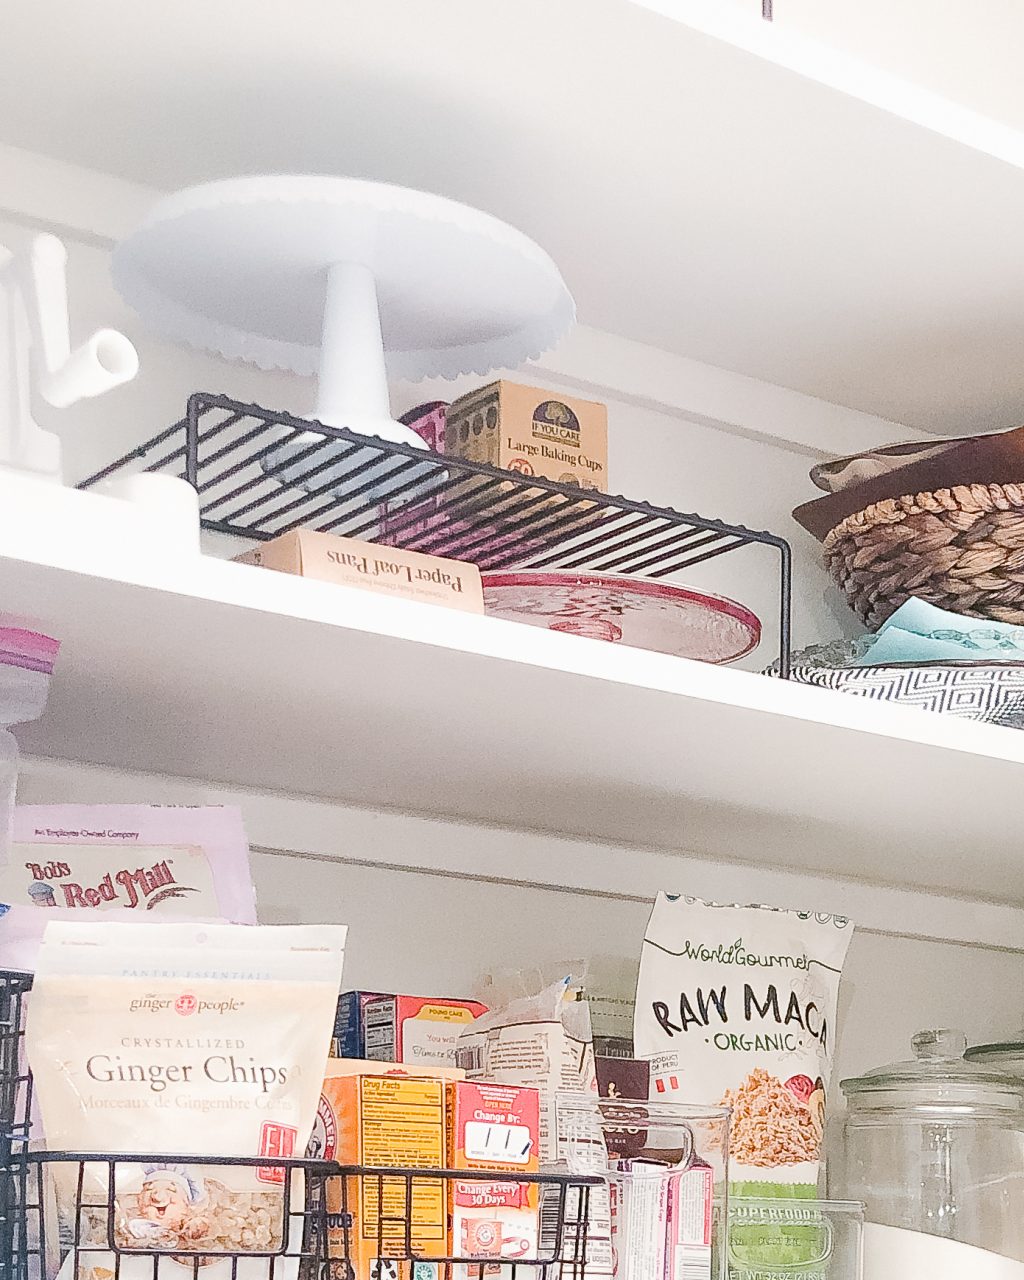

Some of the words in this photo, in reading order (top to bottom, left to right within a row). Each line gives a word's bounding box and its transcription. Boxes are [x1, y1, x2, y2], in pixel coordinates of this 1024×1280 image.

[532, 421, 539, 431] IF
[540, 423, 558, 435] YOU
[559, 429, 581, 441] CARE
[508, 438, 539, 456] Large
[541, 444, 576, 467] Baking
[577, 455, 603, 471] Cups
[327, 550, 368, 575] Pans
[371, 559, 413, 583] Loaf
[414, 567, 464, 593] Paper
[107, 829, 140, 840] Company
[25, 861, 71, 880] Bob's
[60, 873, 119, 909] Red
[116, 859, 177, 909] Mill
[129, 997, 172, 1012] ginger
[197, 999, 239, 1014] people
[652, 986, 728, 1036] RAW
[120, 1037, 247, 1049] CRYSTALLIZED
[713, 1033, 796, 1053] ORGANIC
[86, 1054, 193, 1092] Ginger
[203, 1056, 288, 1093] Chips
[363, 1080, 380, 1090] Drug
[381, 1081, 400, 1090] Facts
[80, 1095, 150, 1110] Morceaux
[153, 1095, 171, 1109] de
[175, 1095, 251, 1113] Gingembre
[473, 1110, 505, 1122] Change
[457, 1182, 490, 1196] Change
[491, 1182, 517, 1197] Every
[471, 1194, 484, 1205] 30
[484, 1194, 506, 1206] Days
